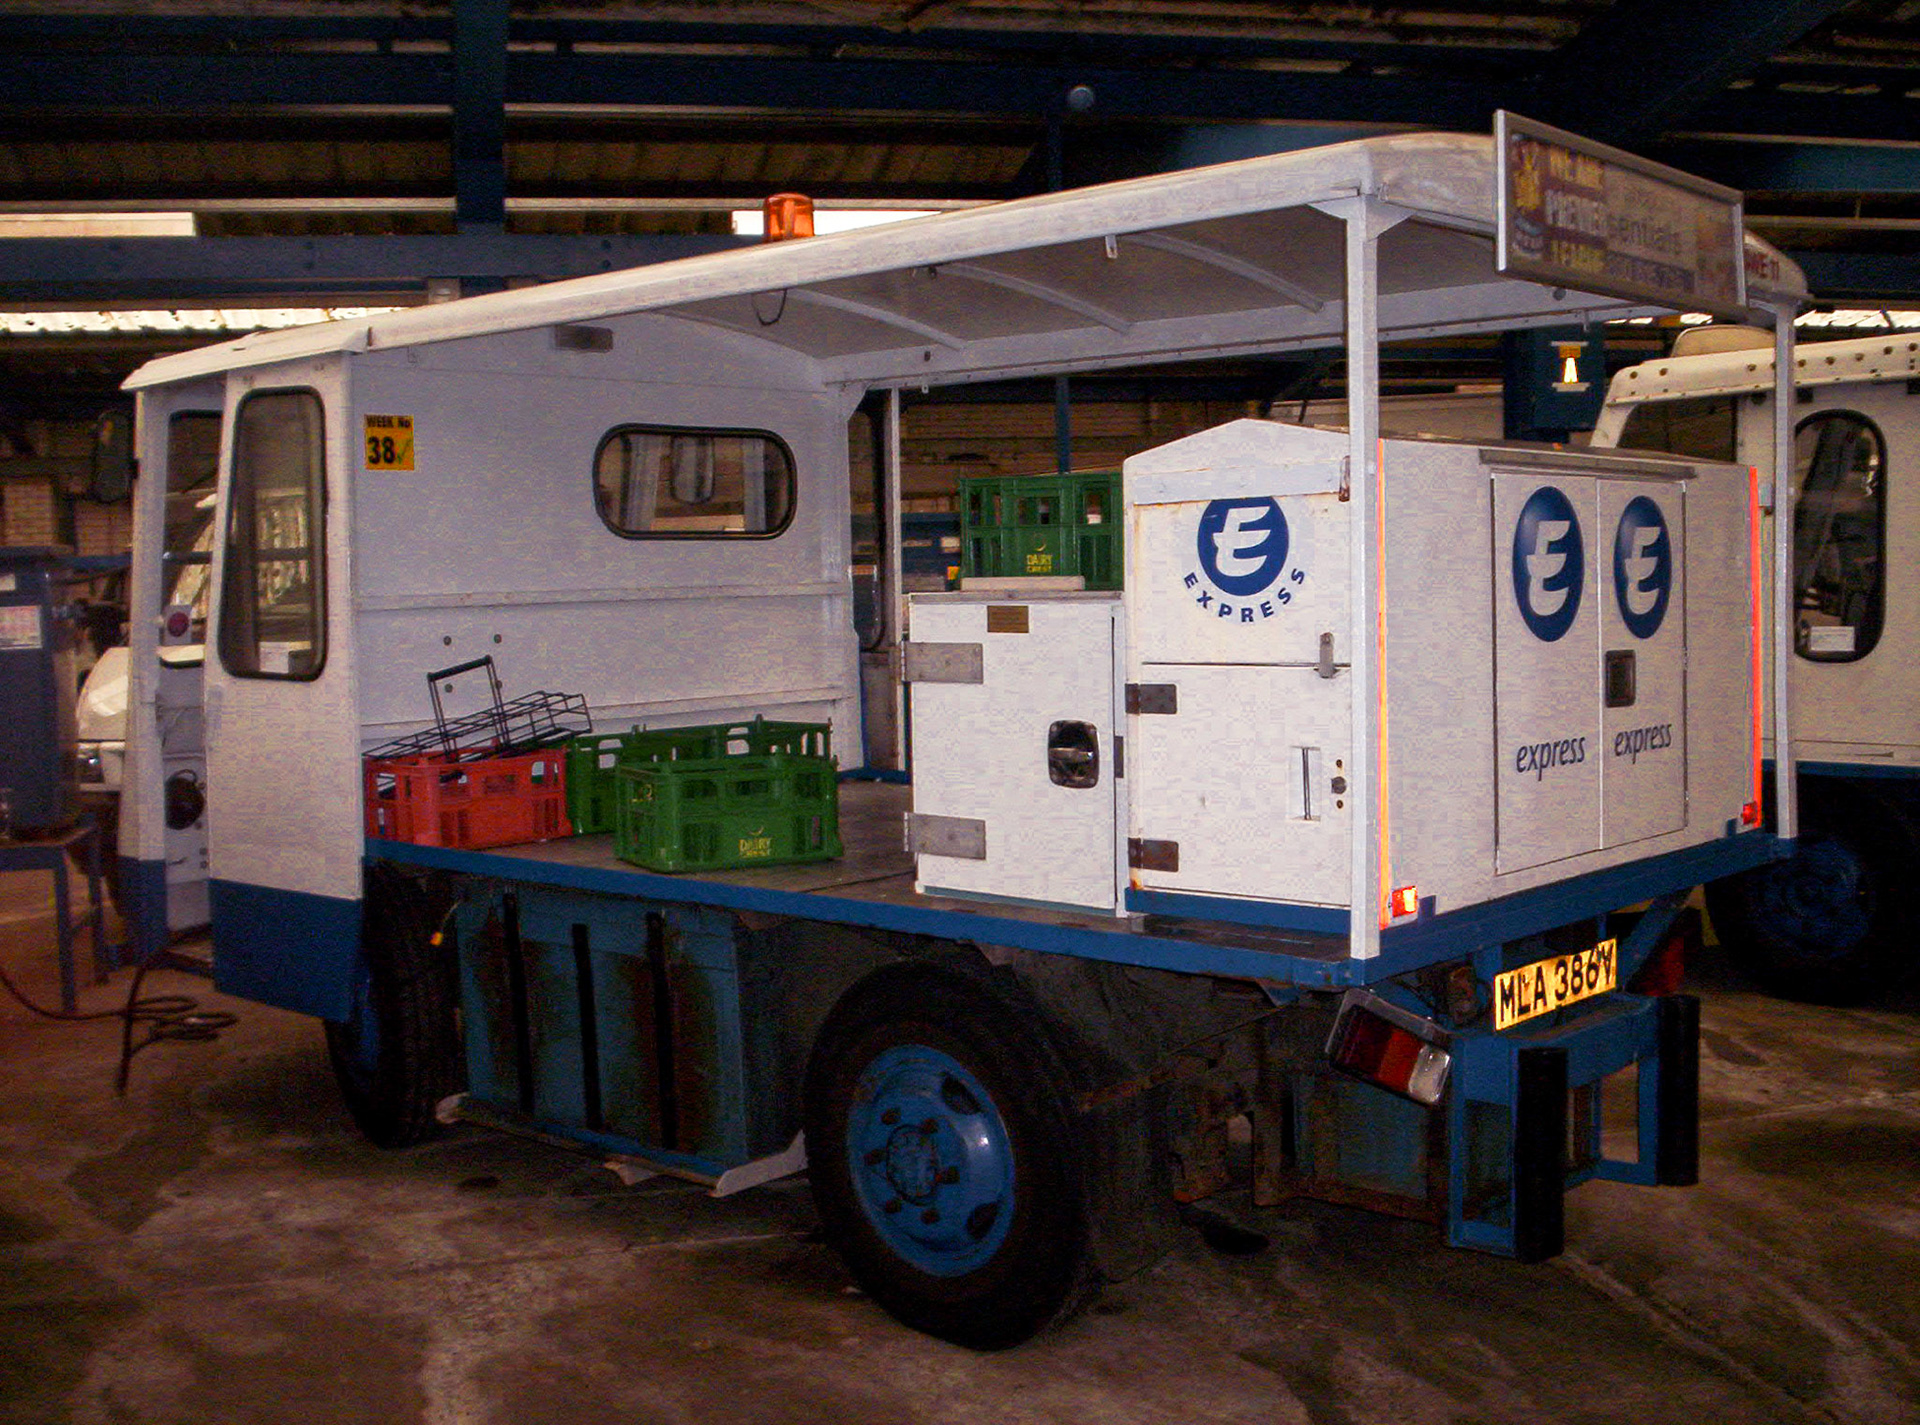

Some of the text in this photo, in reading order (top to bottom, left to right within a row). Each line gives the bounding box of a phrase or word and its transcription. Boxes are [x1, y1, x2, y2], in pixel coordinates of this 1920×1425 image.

[368, 436, 395, 464] 38
[1184, 568, 1305, 623] EXPRESS
[1516, 736, 1586, 782] express
[1614, 723, 1672, 765] express
[1500, 964, 1548, 1022] MLA
